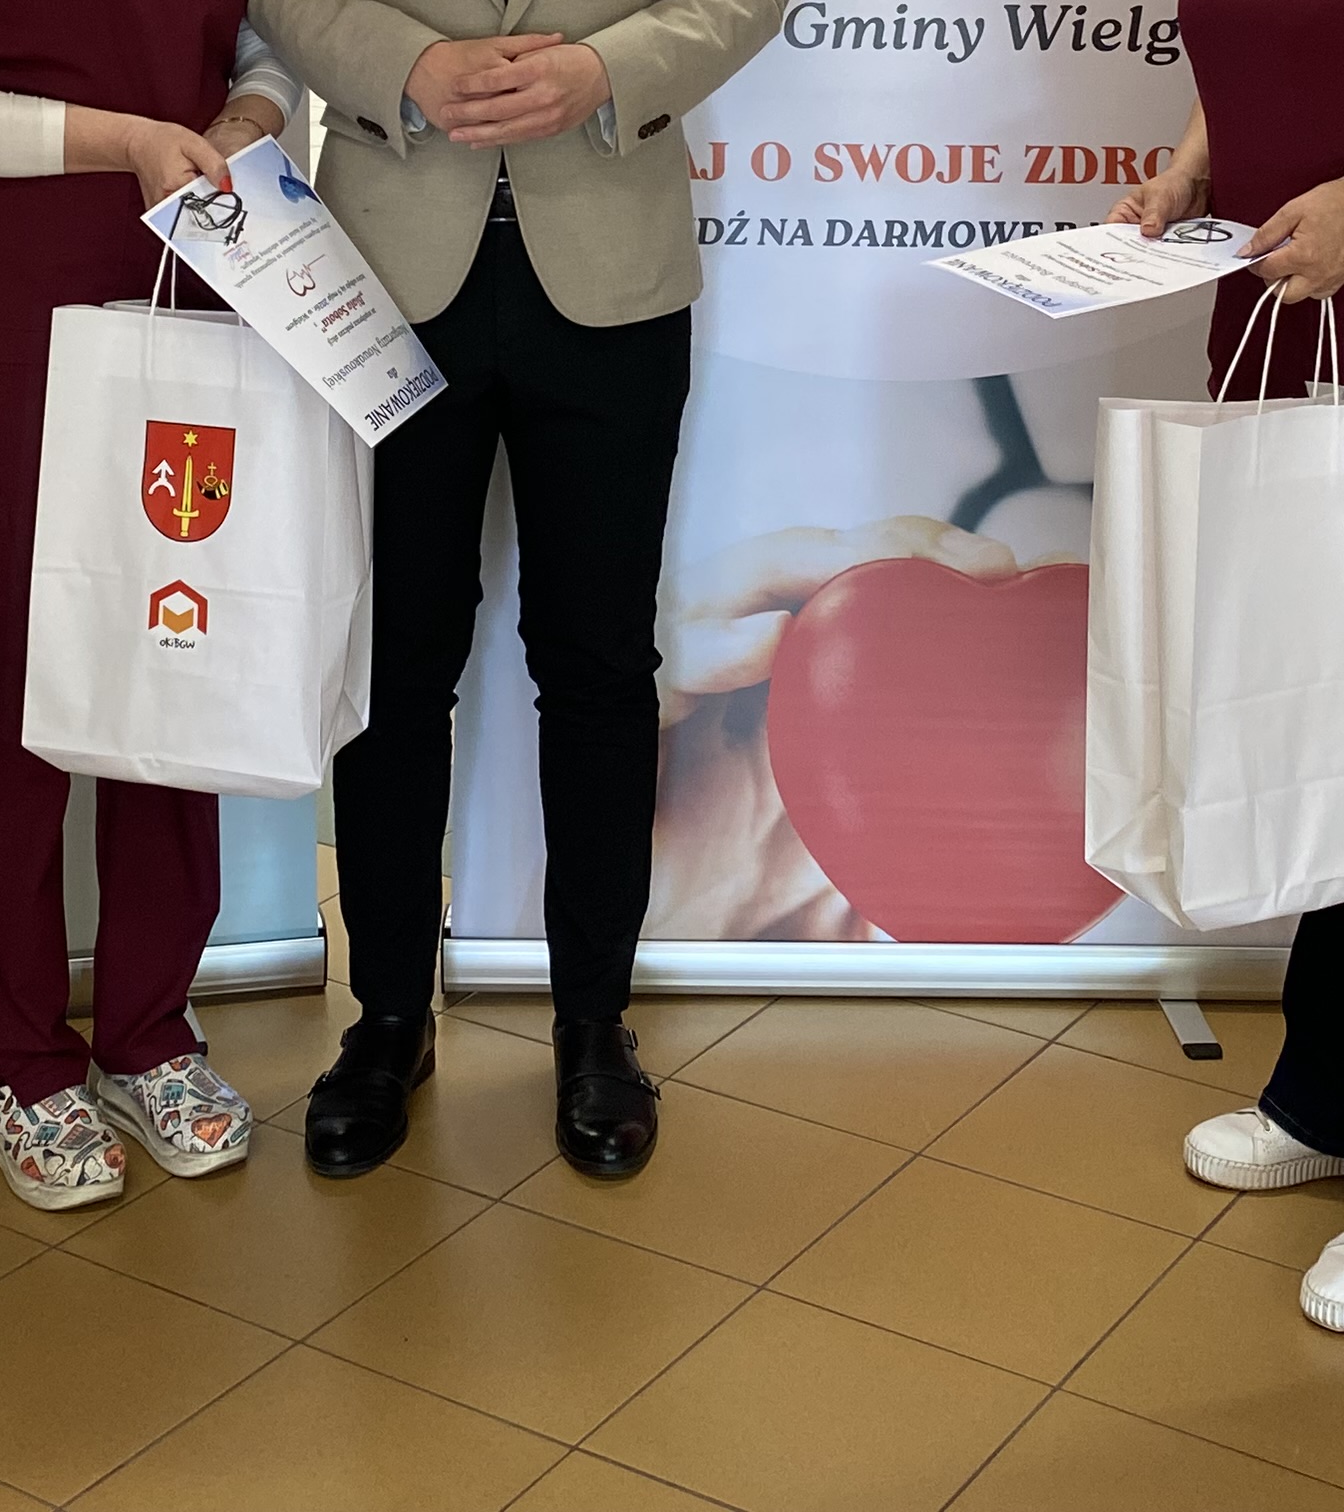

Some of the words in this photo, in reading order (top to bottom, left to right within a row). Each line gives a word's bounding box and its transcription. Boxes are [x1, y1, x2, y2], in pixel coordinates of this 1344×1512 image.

[783, 2, 985, 64] Gminy
[1003, 4, 1180, 66] Wielg
[750, 141, 792, 183] O
[813, 141, 1001, 184] SWOJE
[696, 209, 749, 246] DŹ
[757, 217, 814, 247] NA
[822, 218, 1044, 248] DARMOWE
[364, 365, 437, 431] PODZIĘKOWANIE
